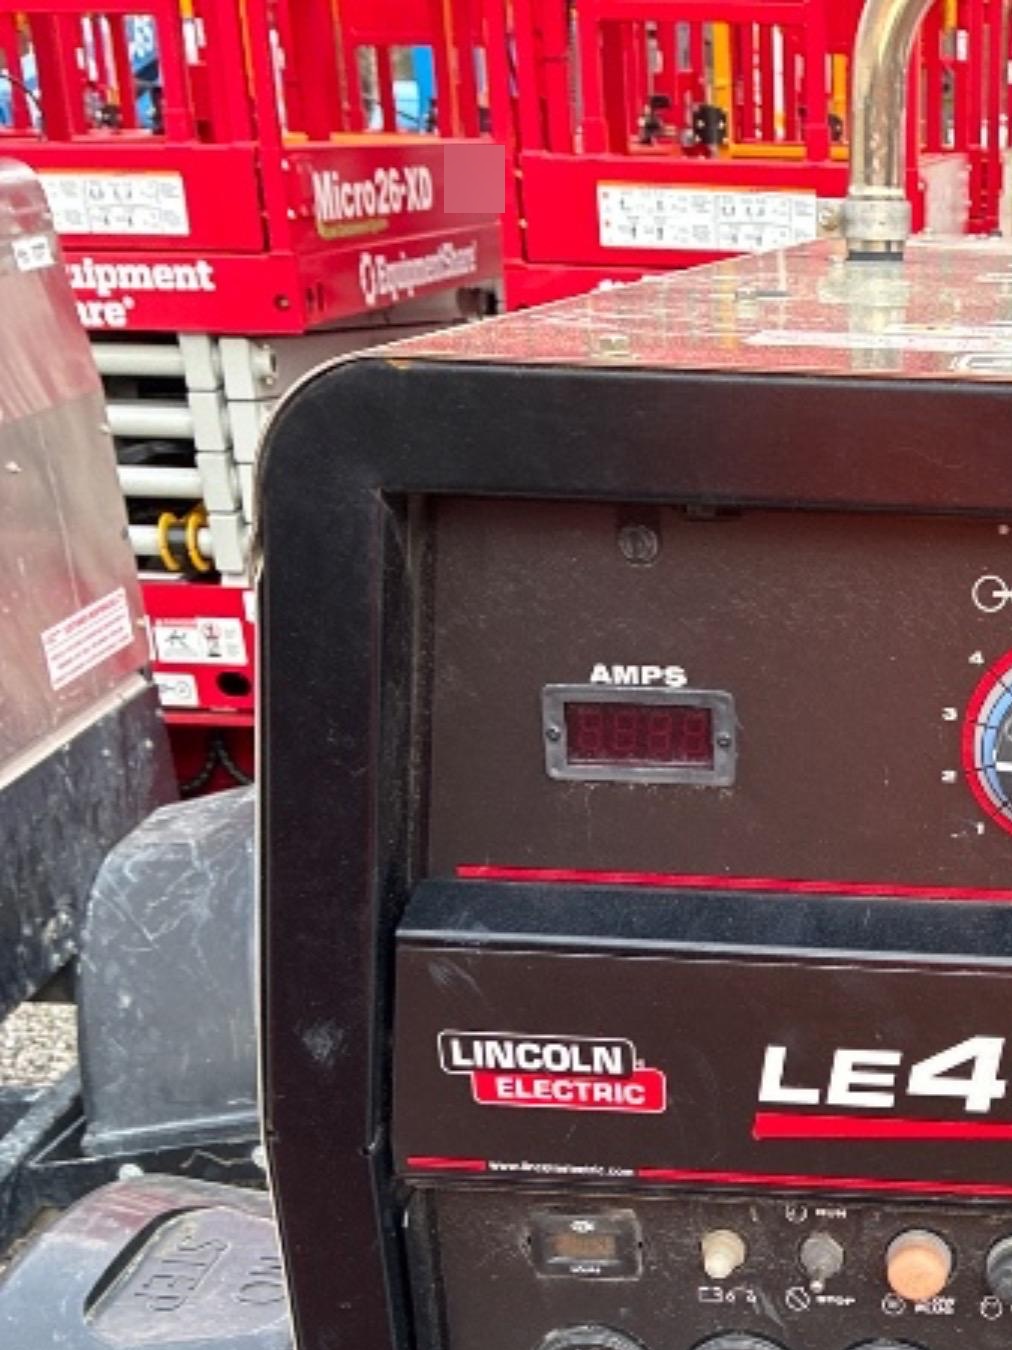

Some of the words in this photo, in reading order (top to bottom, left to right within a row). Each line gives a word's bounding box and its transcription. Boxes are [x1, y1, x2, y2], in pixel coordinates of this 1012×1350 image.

[312, 165, 433, 221] Micro26-XD
[66, 257, 216, 297] uipment
[968, 650, 985, 664] 4
[590, 662, 688, 688] AMPS
[942, 707, 958, 721] 3
[976, 822, 985, 835] 1
[450, 1038, 624, 1074] LINCOLN
[495, 1076, 646, 1105] ELECTRIC
